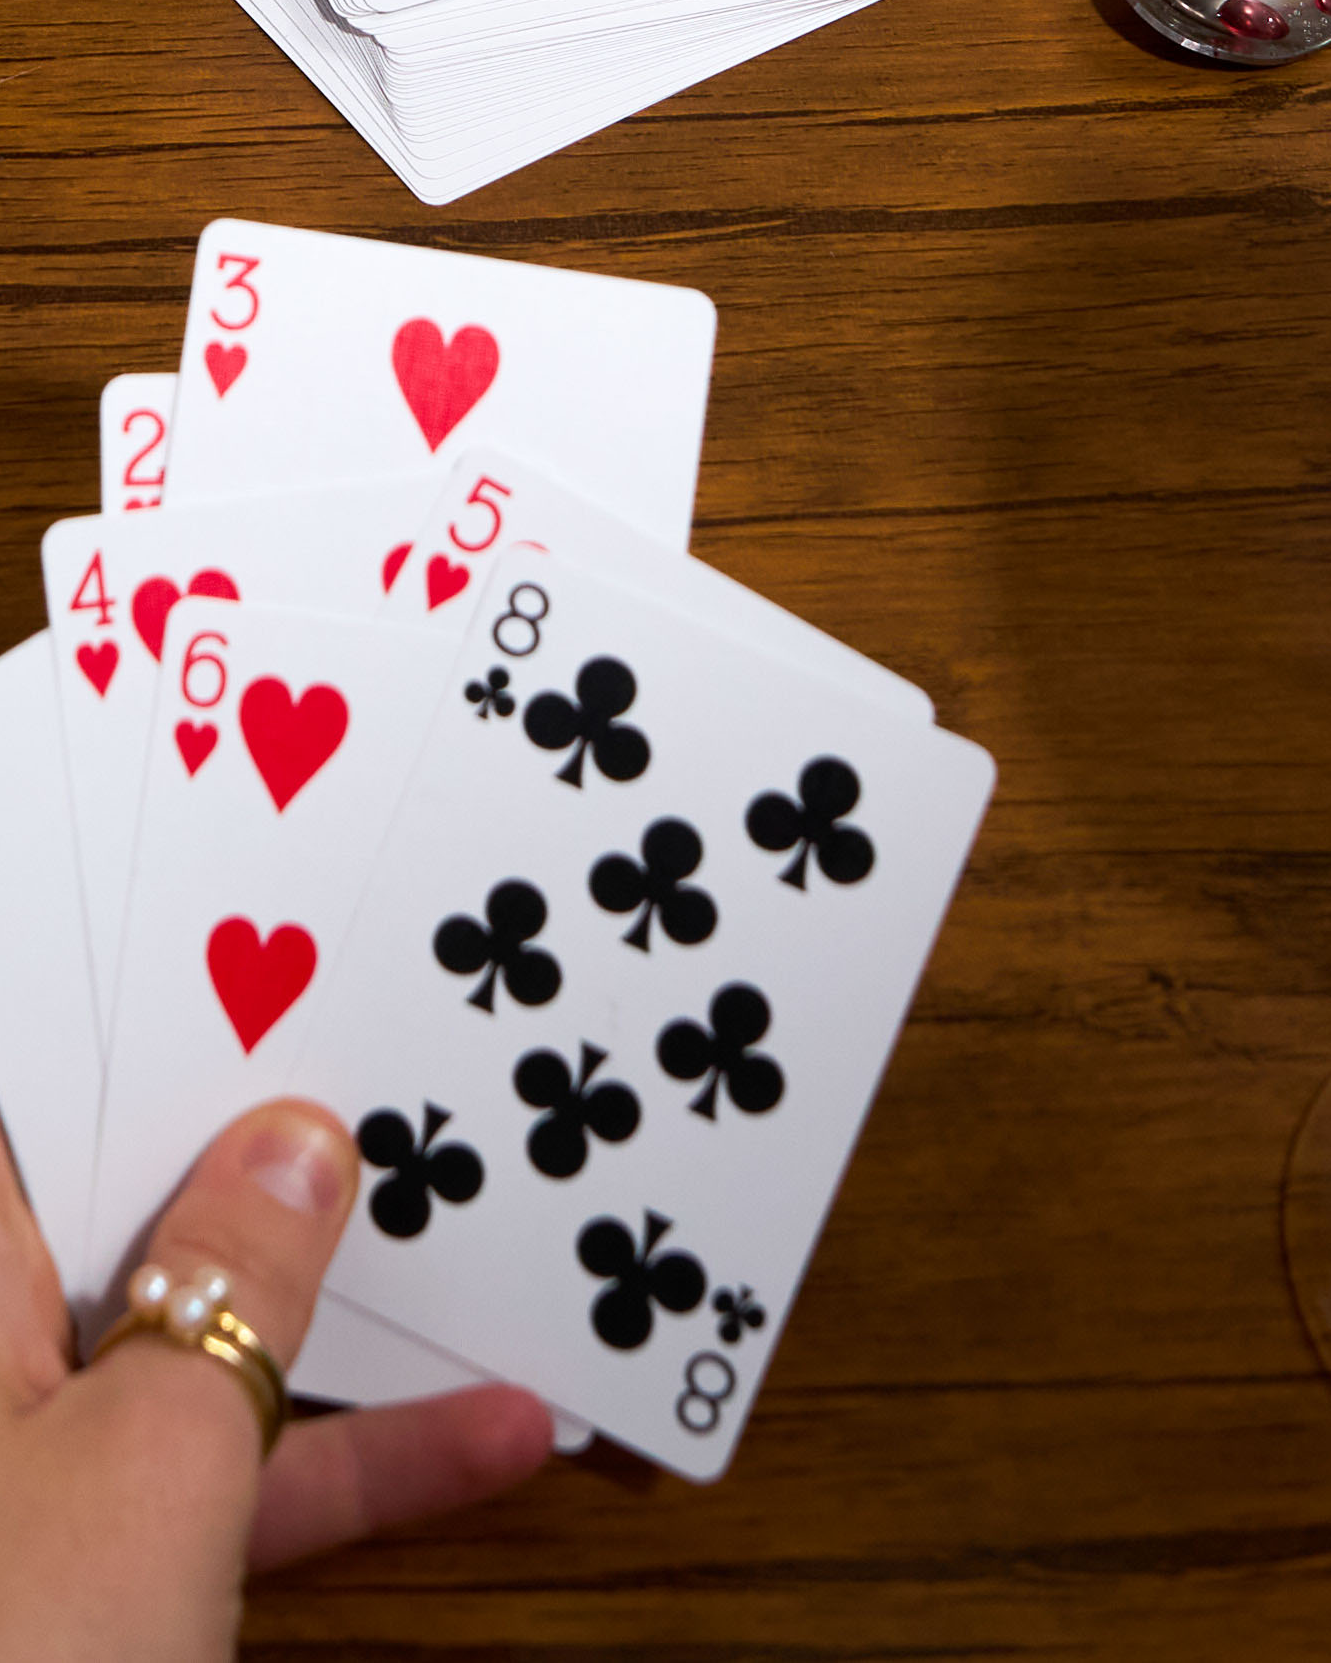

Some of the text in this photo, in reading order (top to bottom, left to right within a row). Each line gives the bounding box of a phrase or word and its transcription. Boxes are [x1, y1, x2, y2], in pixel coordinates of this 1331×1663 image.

[210, 252, 262, 331] 3
[122, 408, 167, 488] 2
[448, 474, 513, 553] 5
[69, 548, 118, 626] 4
[492, 582, 550, 657] 8
[180, 630, 230, 708] 6
[676, 1350, 736, 1436] 8
